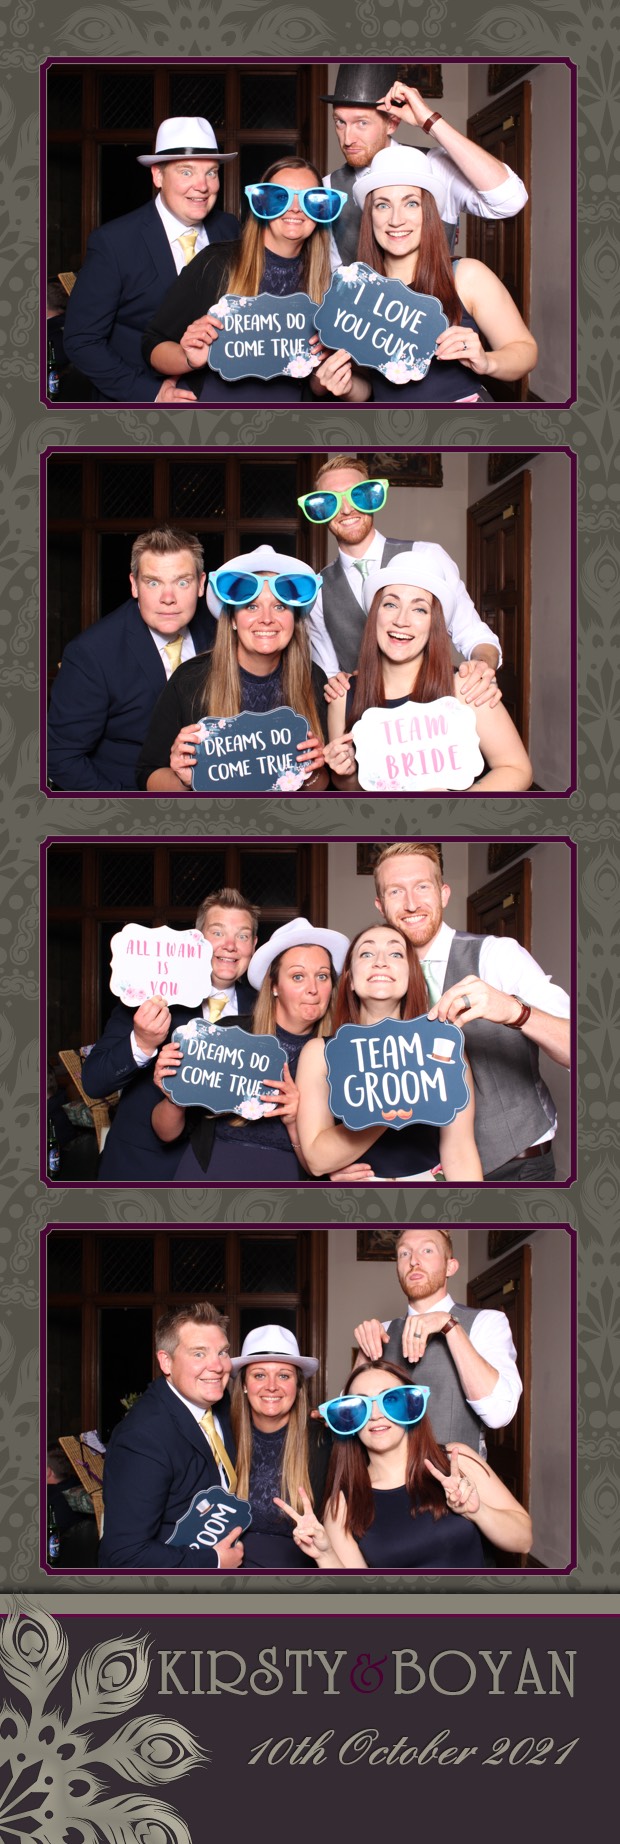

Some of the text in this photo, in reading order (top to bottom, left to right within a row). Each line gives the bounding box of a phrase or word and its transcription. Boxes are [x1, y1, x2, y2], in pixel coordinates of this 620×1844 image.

[224, 313, 305, 334] DREAMS DO
[353, 281, 427, 335] I LOVE
[224, 338, 306, 358] COME TRUE
[334, 308, 419, 365] YOU GUYS
[204, 728, 292, 757] DREAMS DO
[380, 714, 449, 745] TEAM
[208, 753, 294, 782] COME TRUE
[385, 744, 462, 780] BRIDE
[126, 939, 202, 959] ALL I WANT
[158, 961, 169, 975] IS
[150, 980, 178, 997] YOU
[187, 1039, 270, 1073] DREAMS DO
[349, 1032, 425, 1073] TEAM
[181, 1065, 264, 1097] COME TRUE
[343, 1067, 448, 1113] GROOM
